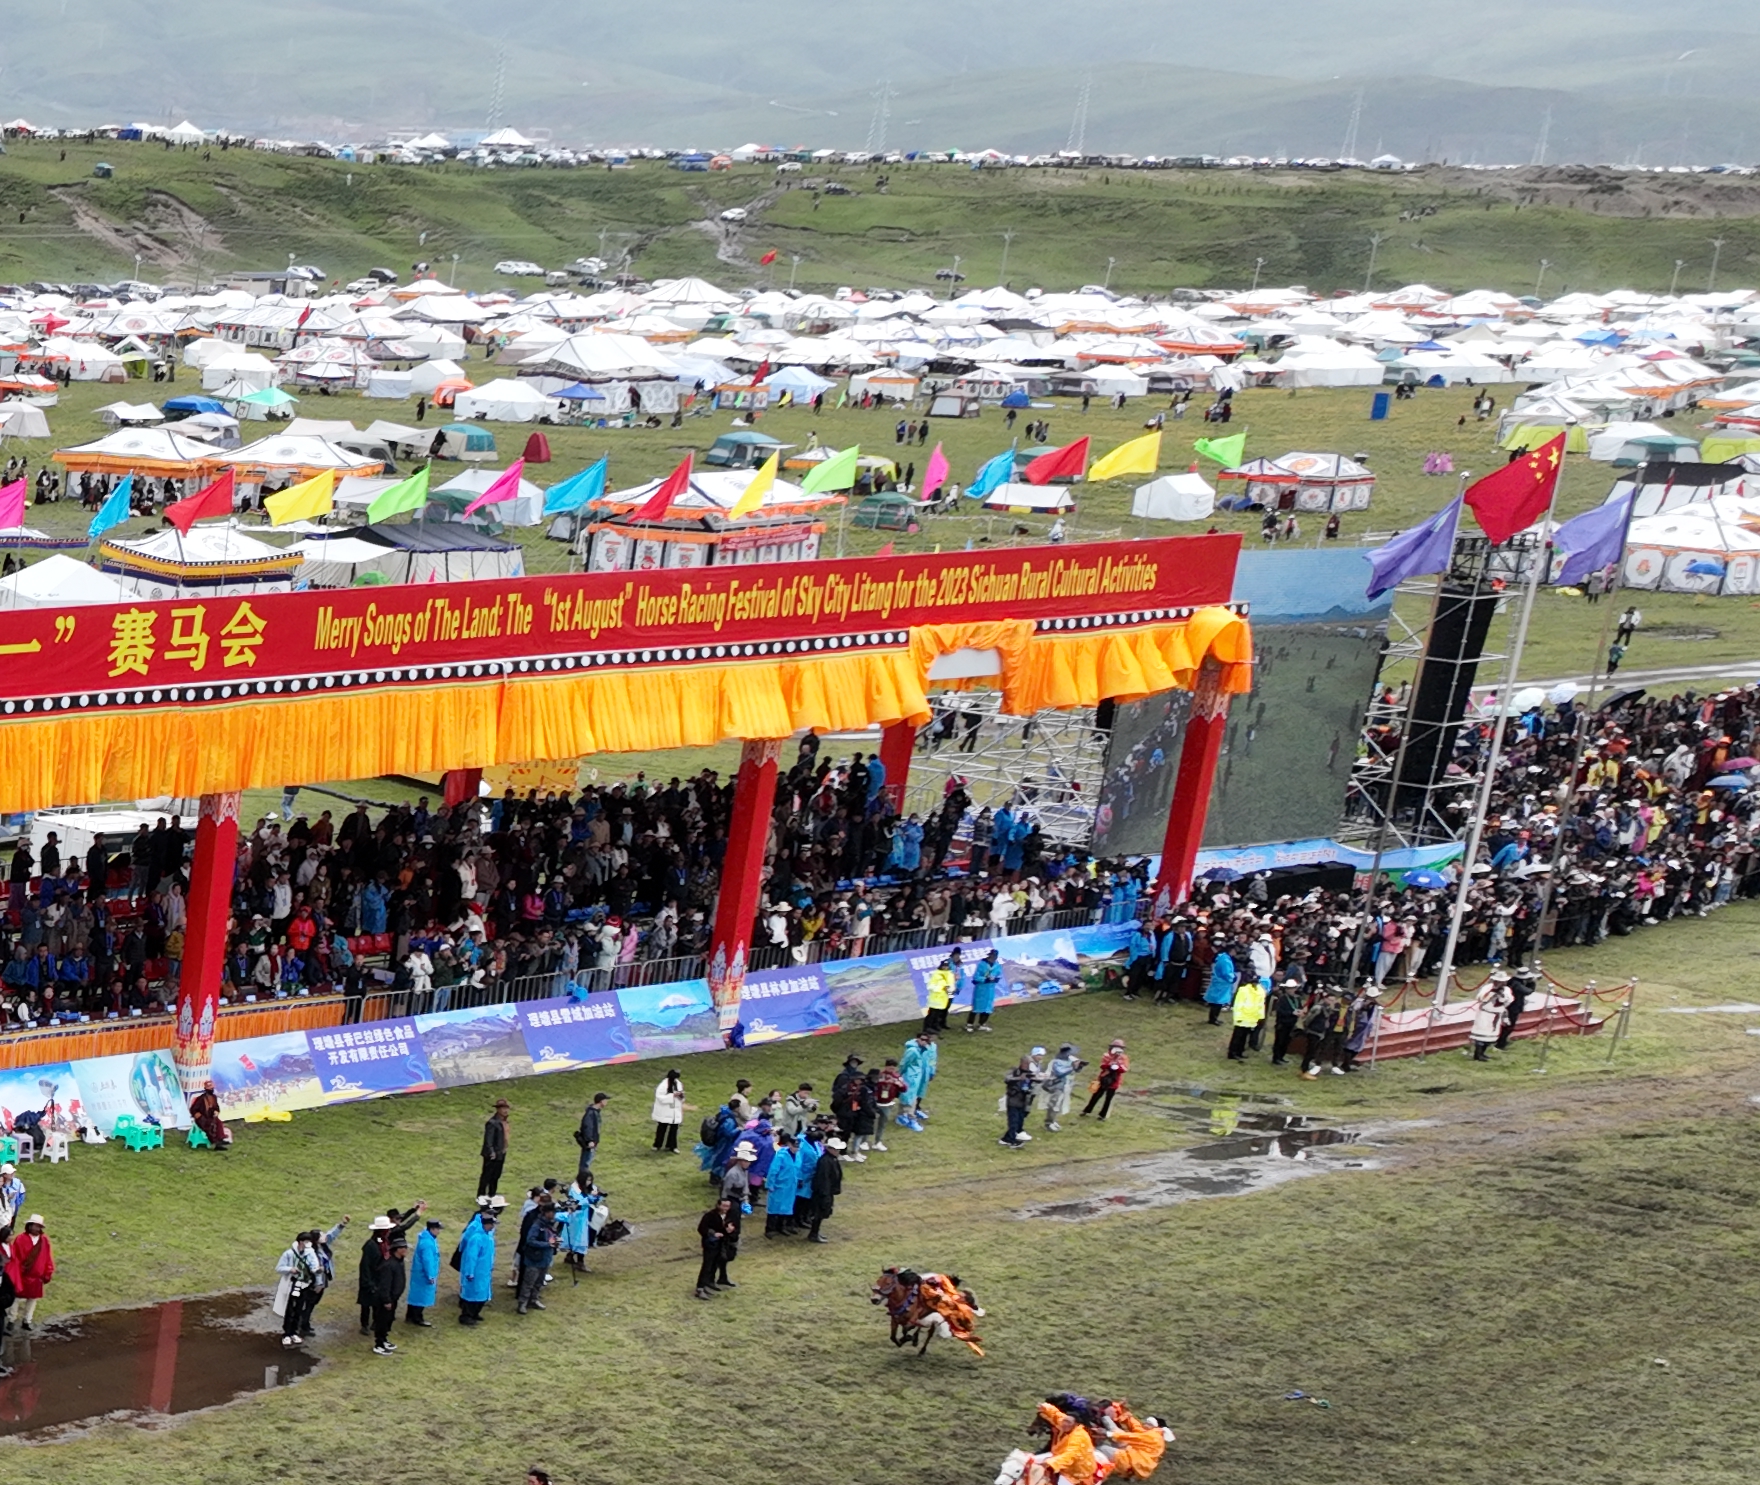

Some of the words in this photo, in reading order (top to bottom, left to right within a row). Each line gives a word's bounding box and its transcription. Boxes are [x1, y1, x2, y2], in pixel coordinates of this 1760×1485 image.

[315, 607, 362, 656] Merry
[364, 603, 412, 654] Songs
[414, 599, 432, 642] of
[434, 599, 460, 640] The
[462, 595, 502, 638] Land:
[507, 593, 532, 634] The
[572, 582, 633, 639] August”
[636, 586, 677, 626] Horse
[679, 583, 726, 631] Racing
[727, 579, 779, 620] Festival
[780, 576, 797, 616] of
[797, 576, 822, 623] Sky
[822, 574, 851, 620] City
[851, 573, 895, 618] Litang
[895, 570, 916, 608] for
[916, 569, 938, 607] the
[938, 567, 968, 605] 2023
[968, 565, 1020, 603] Sichuan
[1020, 561, 1052, 599] Rural
[1052, 559, 1100, 597] Cultural
[1101, 554, 1157, 593] Activities
